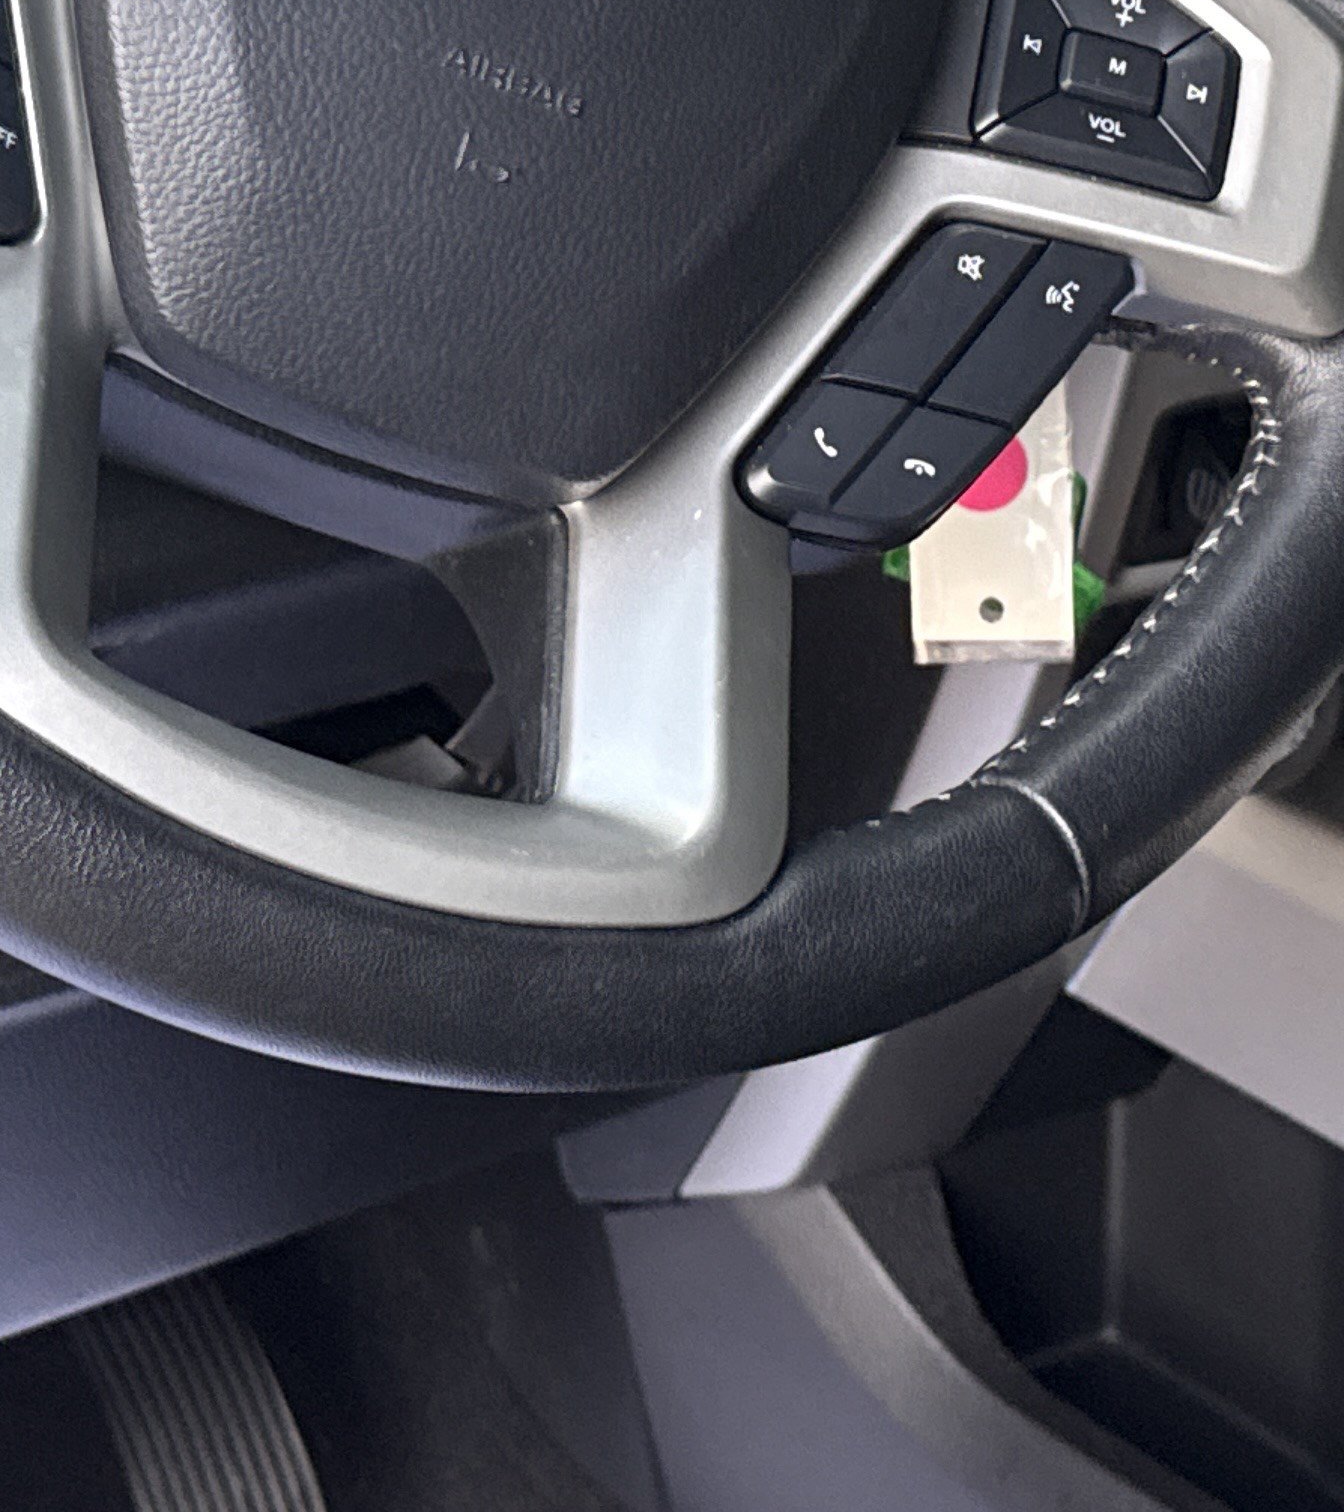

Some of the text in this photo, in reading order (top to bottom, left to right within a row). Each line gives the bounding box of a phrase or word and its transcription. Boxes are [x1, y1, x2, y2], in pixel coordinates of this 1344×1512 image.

[1108, 57, 1127, 76] M
[440, 46, 584, 117] AIRBAG
[1087, 111, 1128, 139] VOL
